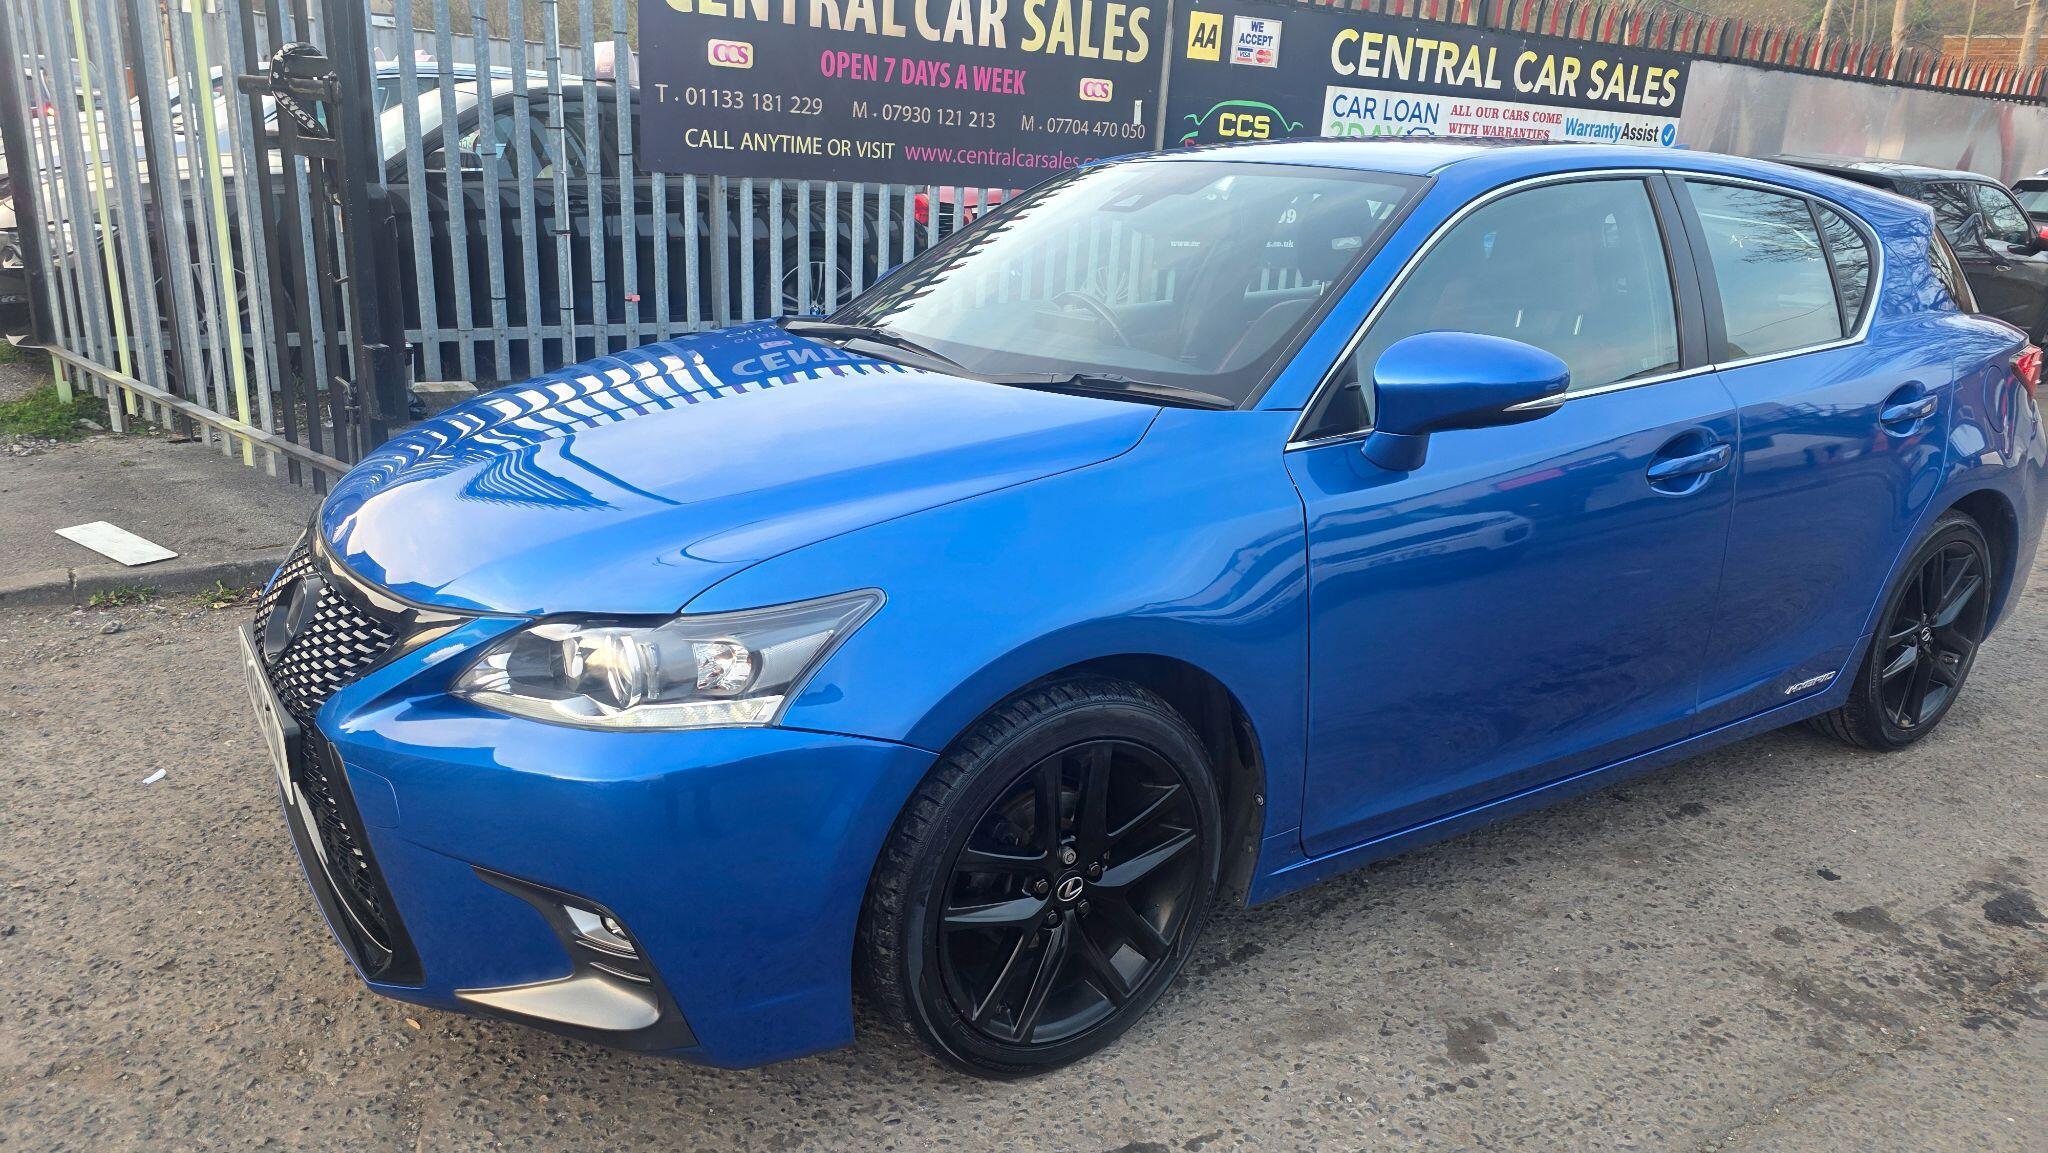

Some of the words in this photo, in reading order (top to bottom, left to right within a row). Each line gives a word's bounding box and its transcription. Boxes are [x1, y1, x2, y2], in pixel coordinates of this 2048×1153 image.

[914, 0, 1008, 49] CAR
[1020, 0, 1151, 64] SALES
[1191, 22, 1218, 50] AA
[1239, 32, 1273, 46] ACCEPT
[1251, 20, 1264, 33] WE
[820, 49, 878, 82] OPEN
[883, 57, 896, 83] 7
[901, 58, 951, 88] DAYS
[955, 64, 968, 91] A
[973, 66, 1026, 96] WEEK
[1330, 28, 1502, 90] CENTRAL
[1513, 50, 1581, 97] CAR
[1586, 59, 1680, 107] SALES
[686, 87, 744, 109] 01133
[752, 93, 781, 112] 181
[789, 96, 823, 115] 229
[1332, 94, 1377, 120] CAR
[1383, 99, 1440, 125] LOAN
[1450, 104, 1472, 117] ALL
[1475, 106, 1499, 119] OUR
[1502, 108, 1530, 122] CARS
[1532, 111, 1563, 125] COME
[882, 103, 931, 124] 07930
[937, 108, 962, 126] 121
[969, 111, 996, 129] 213
[1047, 117, 1089, 135] 07704
[1093, 121, 1117, 137] 470
[1121, 123, 1146, 139] 050
[1219, 112, 1270, 139] CCS
[684, 128, 735, 150] CALL
[740, 132, 822, 155] ANYTIME
[827, 138, 852, 157] OR
[856, 140, 896, 160] VISIT
[1449, 122, 1479, 135] WITH
[1482, 125, 1551, 140] WARRANTIES
